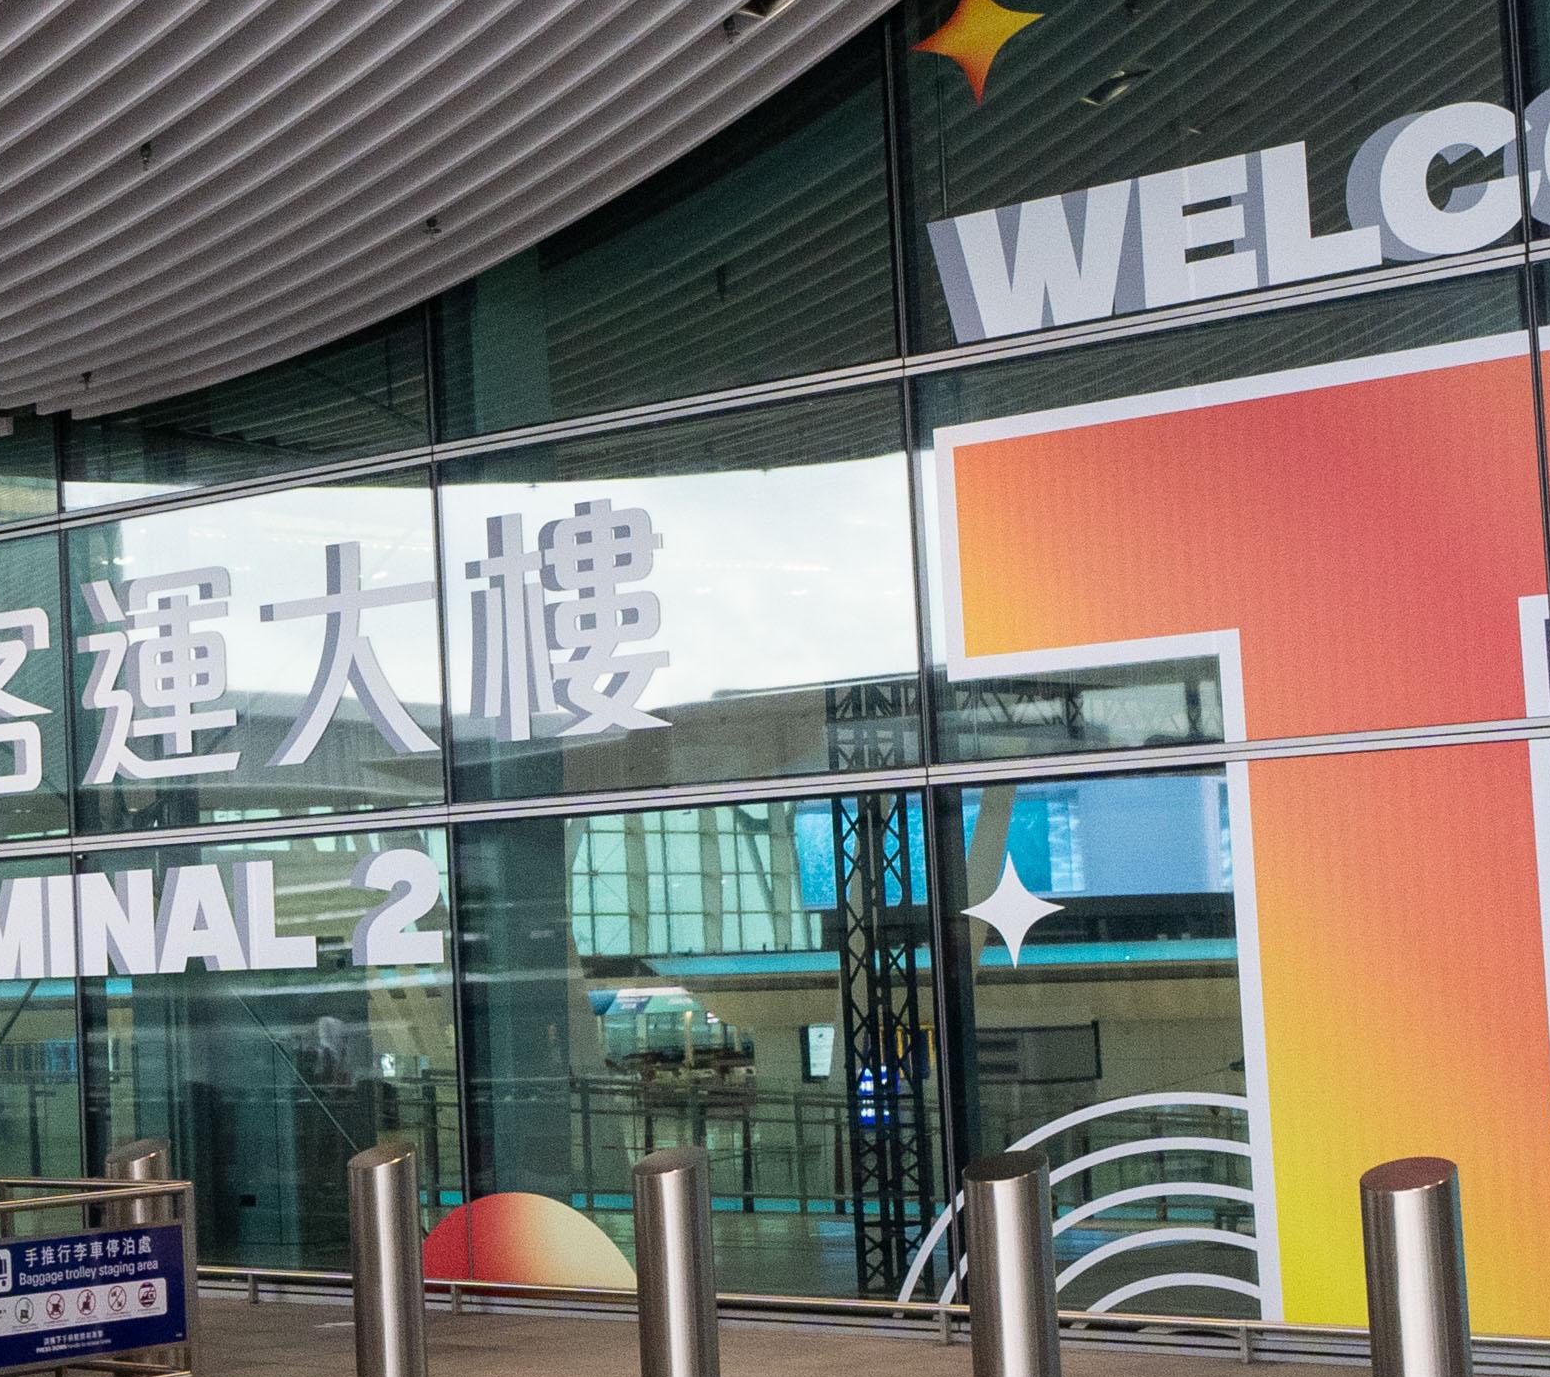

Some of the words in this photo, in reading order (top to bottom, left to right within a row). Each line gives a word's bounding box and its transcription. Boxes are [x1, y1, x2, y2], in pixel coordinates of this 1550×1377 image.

[350, 848, 445, 967] 2
[24, 1235, 152, 1268] 手推行李車停泊處
[19, 1271, 64, 1287] Baggage
[65, 1265, 96, 1281] trolley
[99, 1262, 135, 1278] staging
[137, 1259, 159, 1271] area
